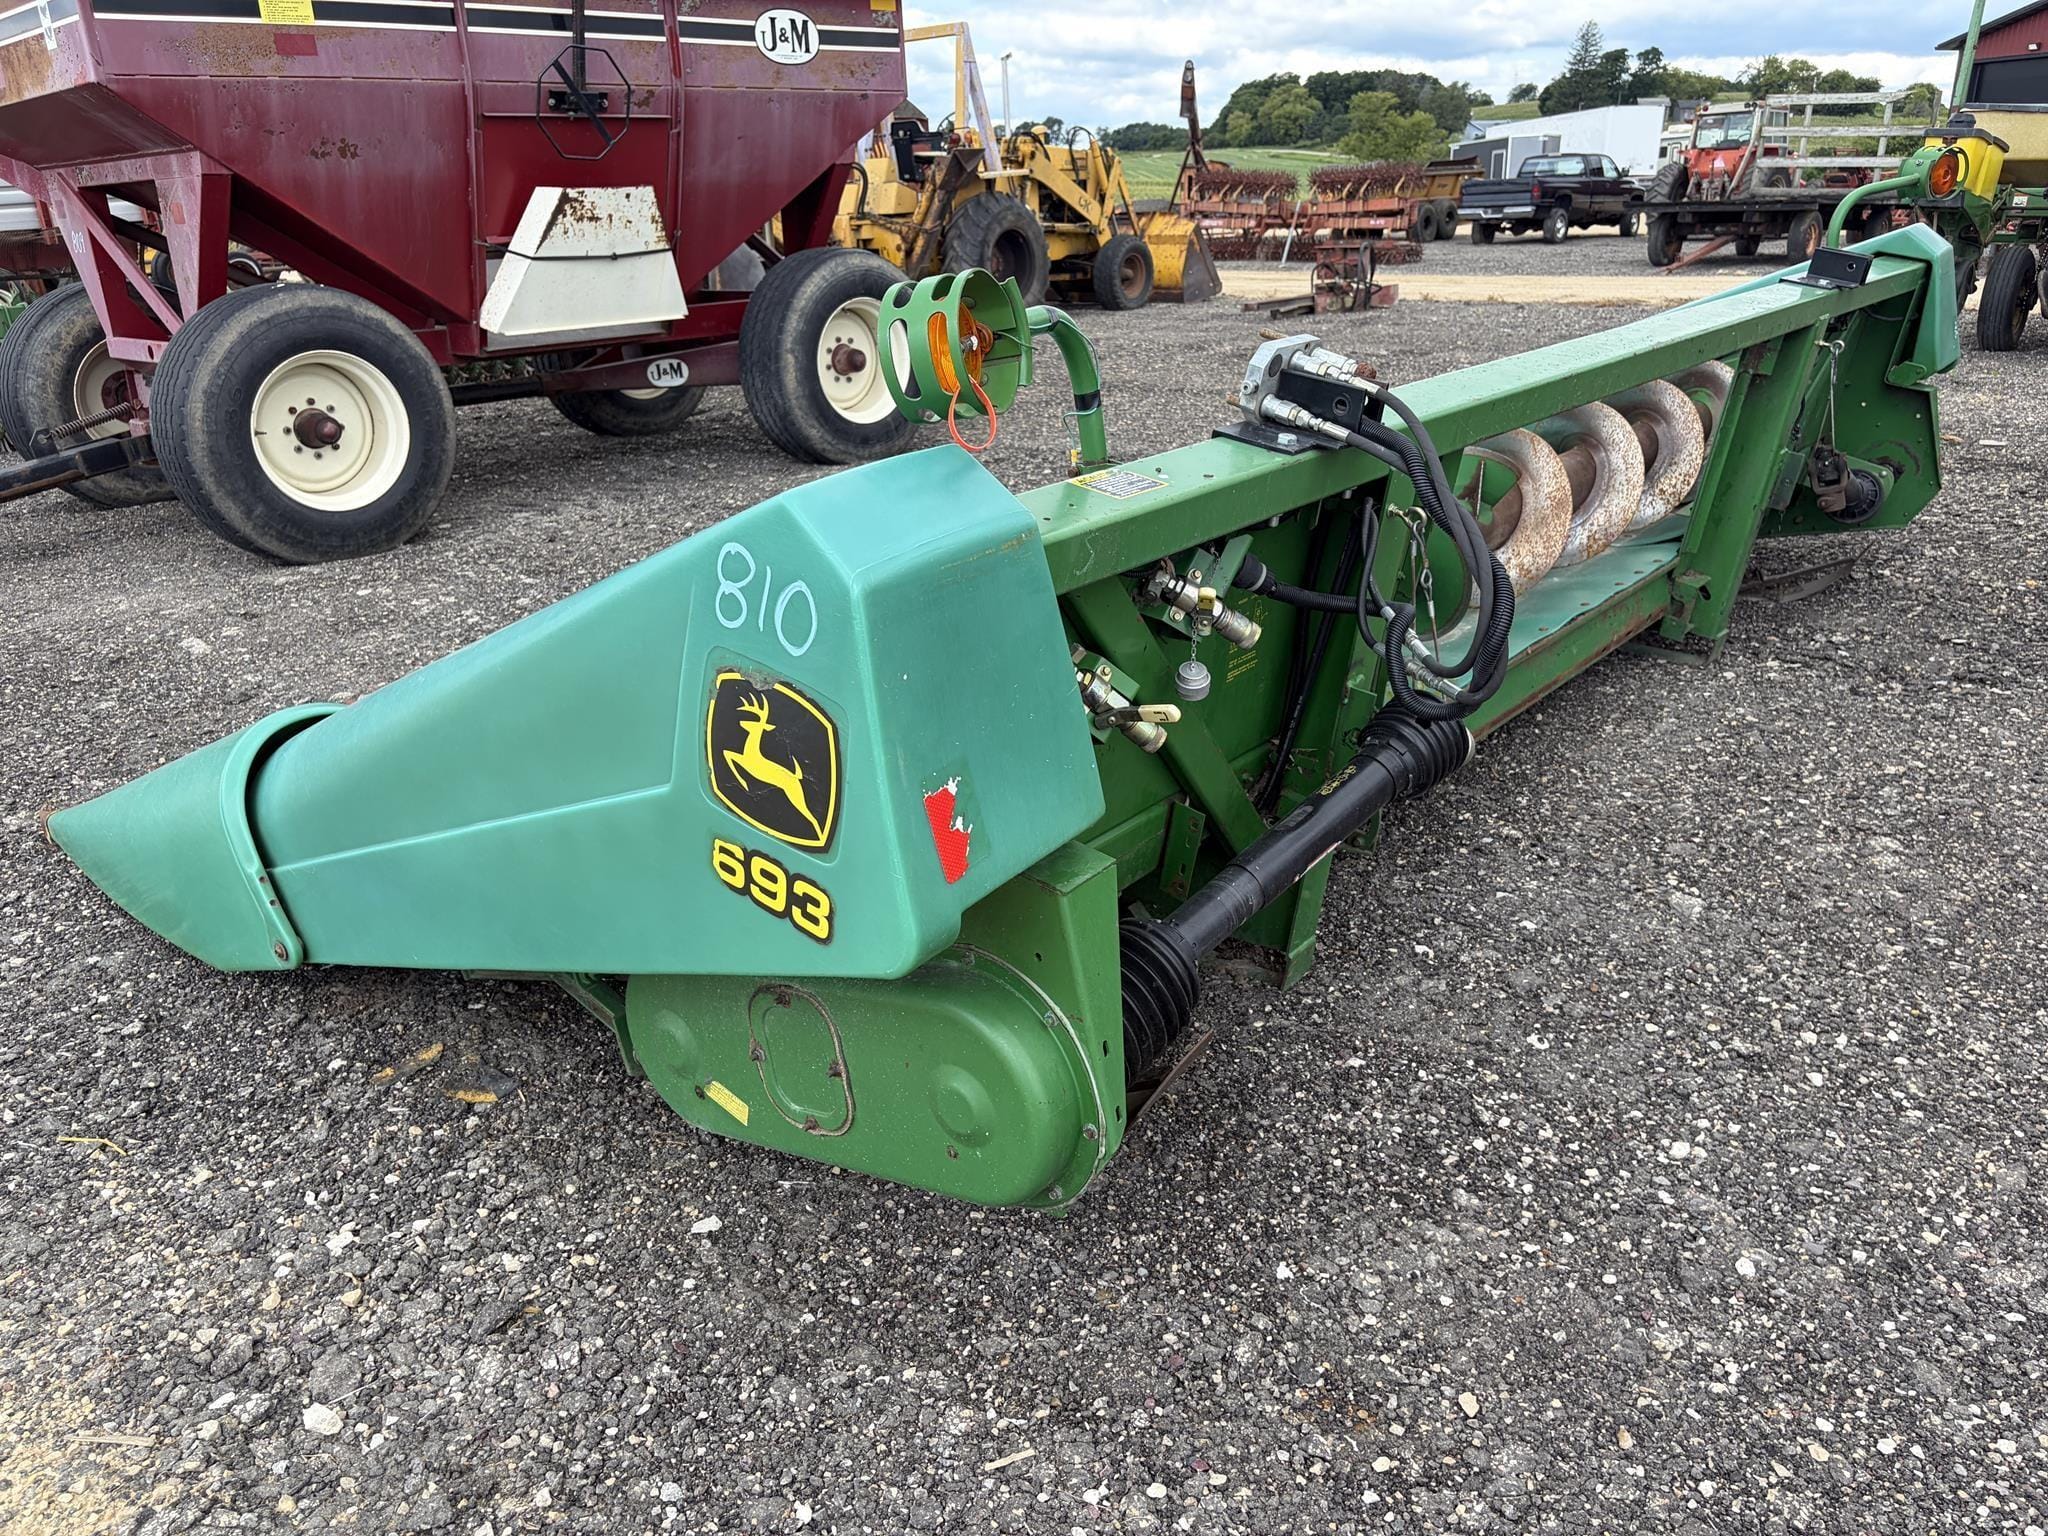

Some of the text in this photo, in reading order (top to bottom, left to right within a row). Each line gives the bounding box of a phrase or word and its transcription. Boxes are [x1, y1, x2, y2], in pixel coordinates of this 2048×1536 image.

[760, 16, 811, 54] J&M
[650, 361, 684, 381] J&M
[715, 541, 819, 657] 810
[712, 838, 832, 944] 693
